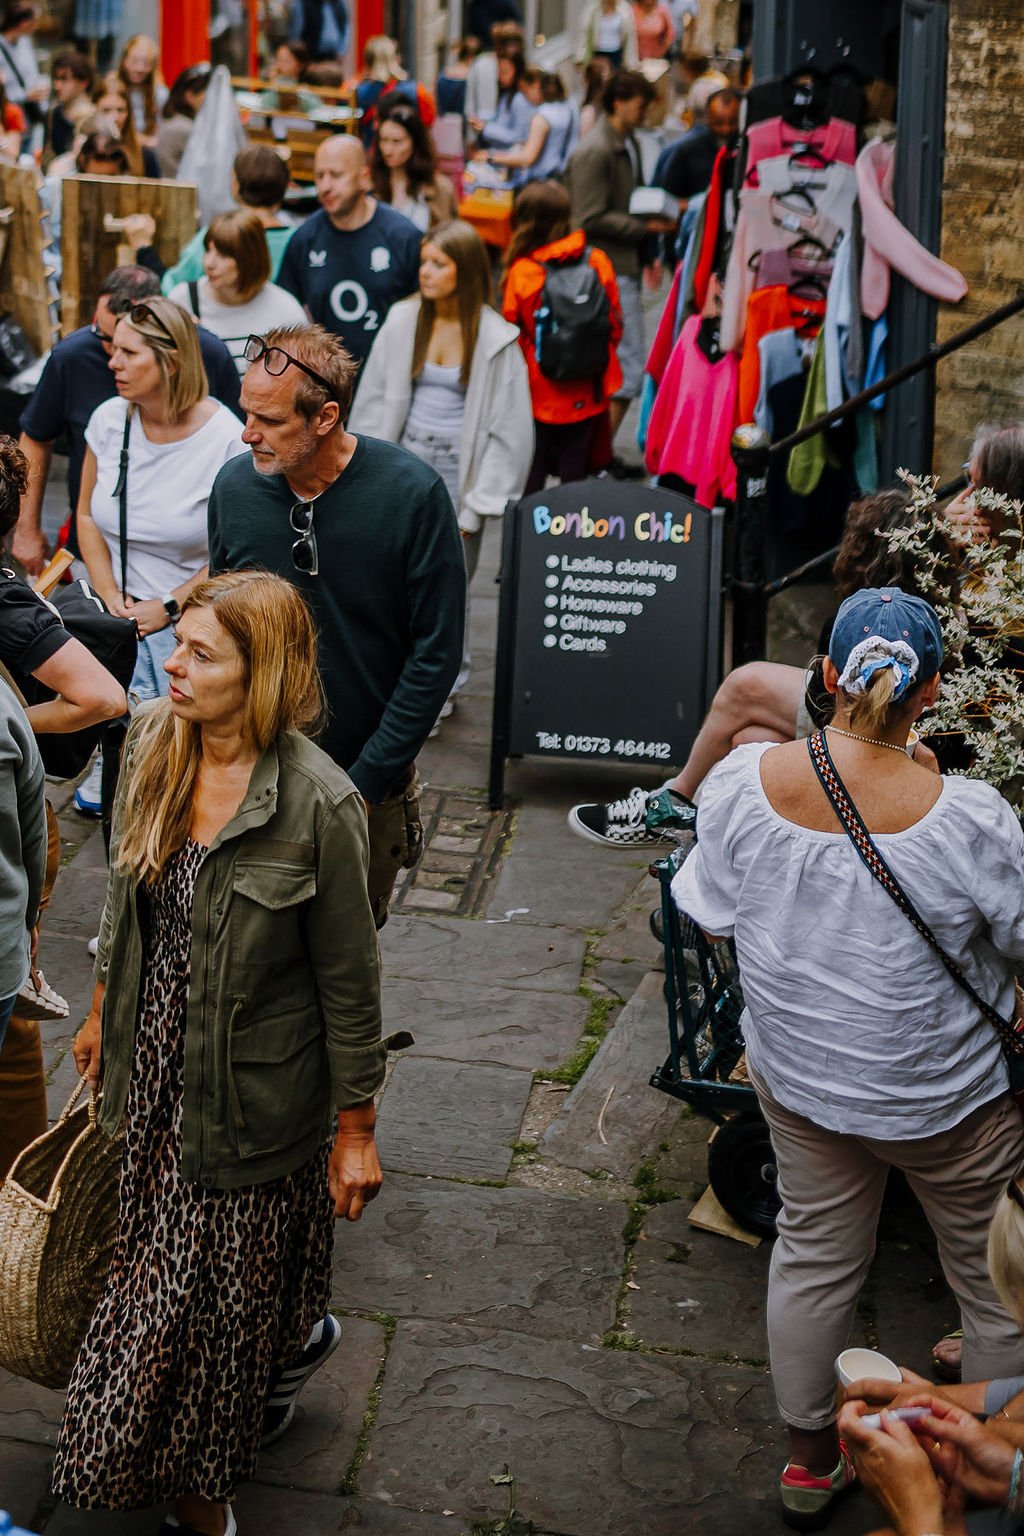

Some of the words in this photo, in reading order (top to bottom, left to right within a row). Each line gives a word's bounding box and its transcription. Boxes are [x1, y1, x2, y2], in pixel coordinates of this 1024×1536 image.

[532, 504, 626, 542] Bonbon
[633, 510, 693, 545] Chic!
[560, 553, 614, 575] Ladies
[616, 558, 678, 583] clothing
[560, 574, 657, 597] Accessories
[559, 593, 644, 616] Homeware
[559, 613, 627, 635] Giftware
[558, 632, 607, 652] Cards
[536, 730, 562, 750] Tel:
[564, 733, 611, 755] 01373
[613, 738, 671, 760] 464412
